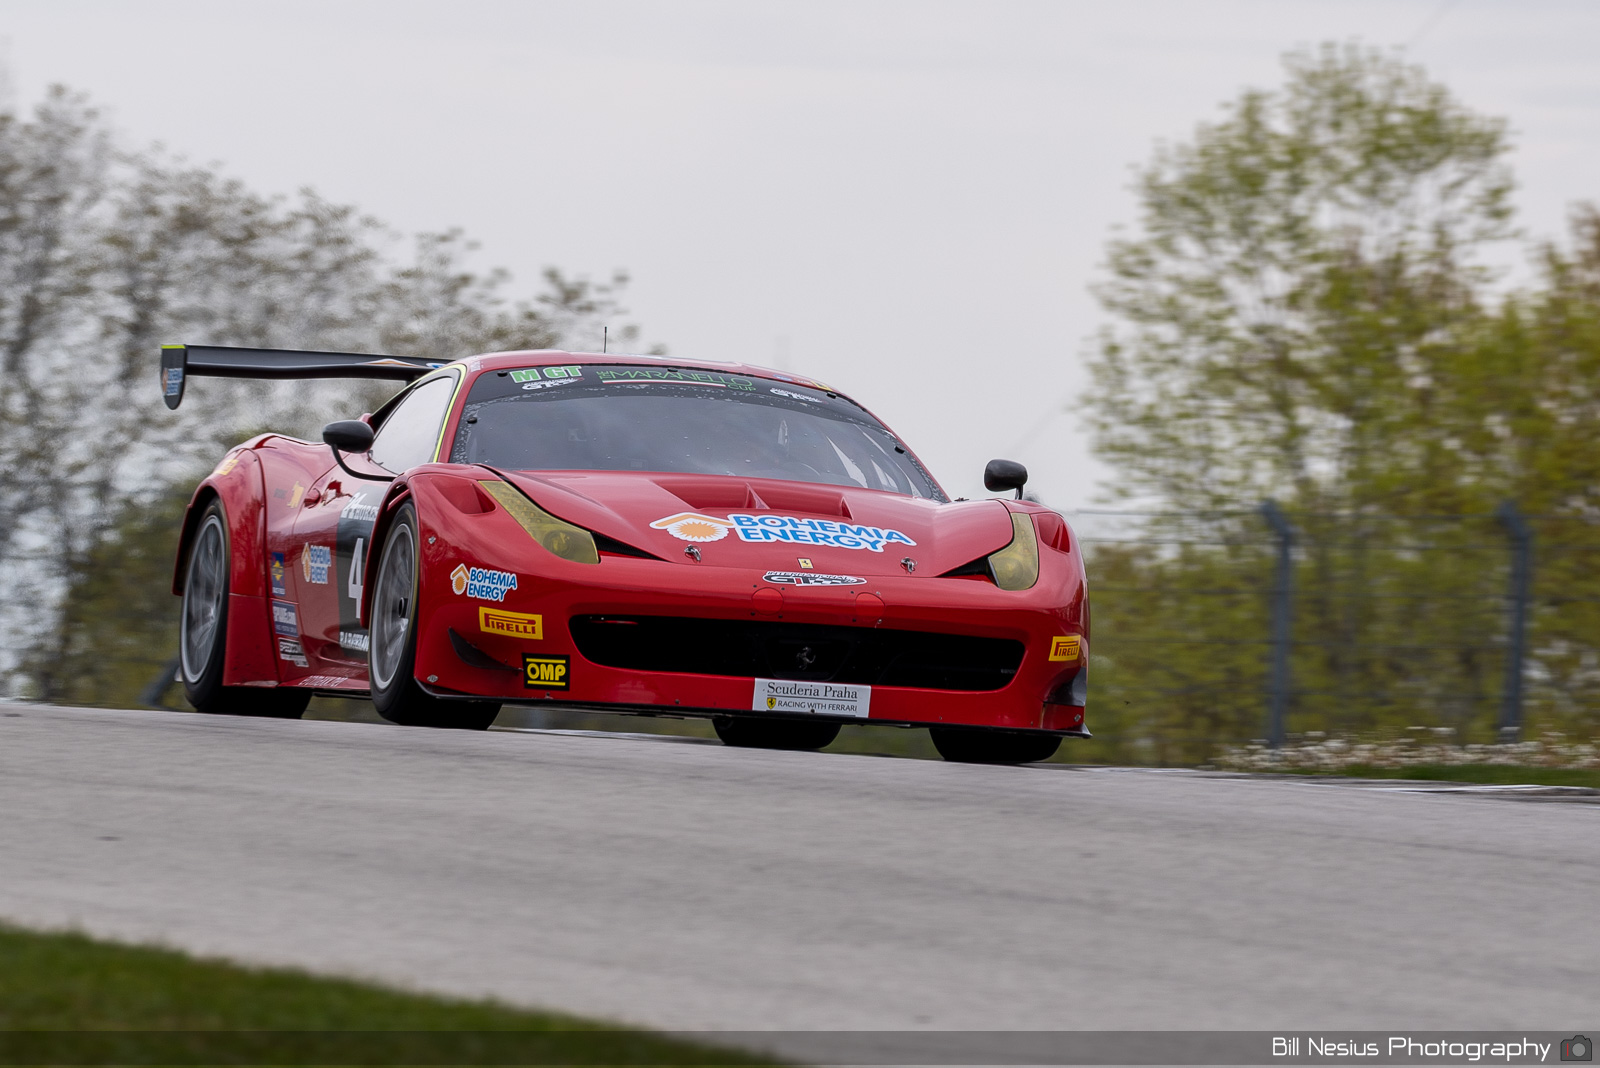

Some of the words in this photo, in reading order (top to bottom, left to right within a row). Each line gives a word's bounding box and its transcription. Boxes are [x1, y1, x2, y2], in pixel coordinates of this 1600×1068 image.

[509, 368, 542, 384] M
[543, 366, 583, 379] GT
[609, 370, 753, 388] MARANELLO
[732, 516, 912, 544] BOHEMIA
[740, 528, 883, 550] ENERGY
[348, 537, 364, 619] 4
[470, 570, 517, 589] BOHEMIA
[469, 585, 506, 601] ENERGY
[485, 613, 536, 634] PIRELLI
[1054, 640, 1079, 657] PIRELLI
[527, 663, 567, 681] OMP
[767, 682, 820, 697] Scuderia
[823, 686, 858, 699] Praha
[777, 700, 807, 709] RACING
[807, 701, 827, 710] WITH
[828, 703, 857, 712] FERRARI
